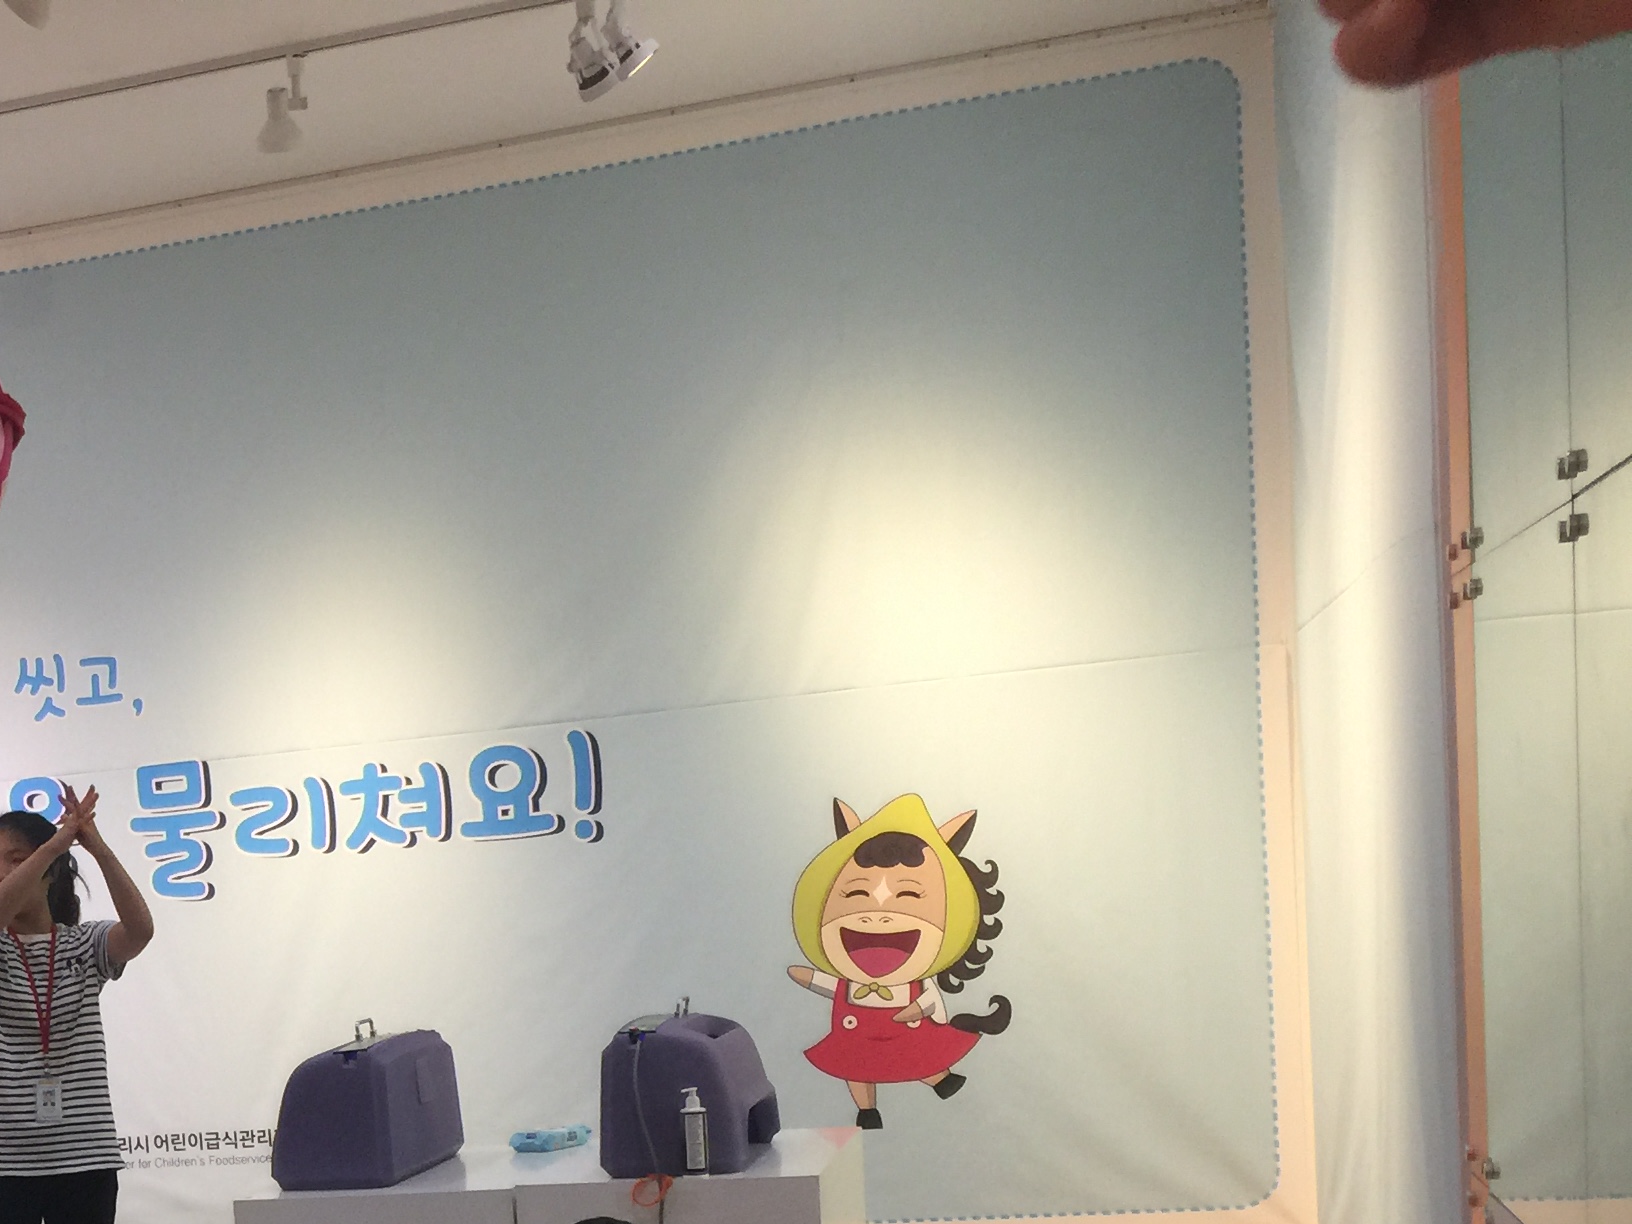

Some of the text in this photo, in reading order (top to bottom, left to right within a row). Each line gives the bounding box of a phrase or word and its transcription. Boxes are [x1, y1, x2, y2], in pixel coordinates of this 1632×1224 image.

[13, 653, 145, 722] 씻고,
[129, 728, 605, 903] 물리쳐요!
[138, 1158, 151, 1169] for
[155, 1155, 206, 1168] Children's
[209, 1153, 273, 1166] Foodservice
[153, 1128, 278, 1153] 어린이급식관리
